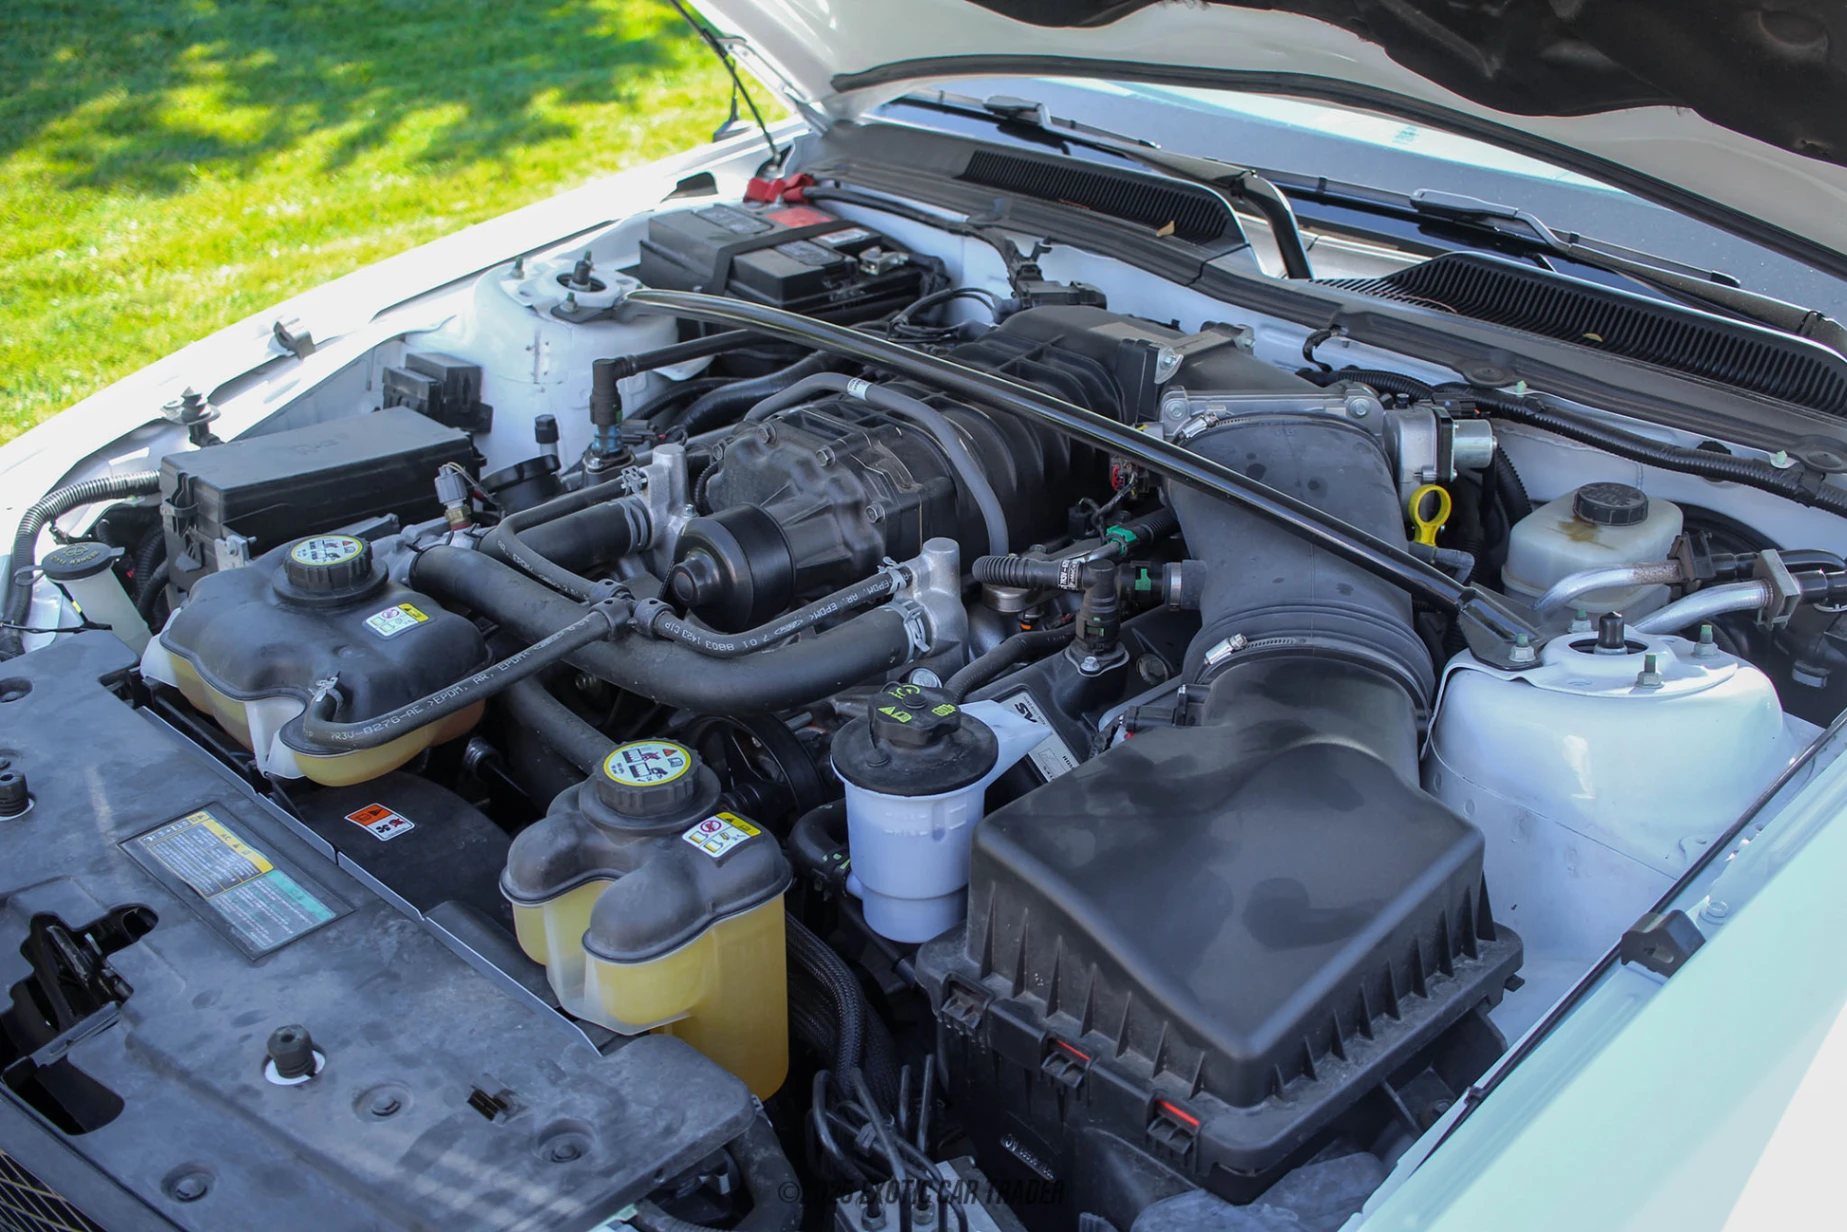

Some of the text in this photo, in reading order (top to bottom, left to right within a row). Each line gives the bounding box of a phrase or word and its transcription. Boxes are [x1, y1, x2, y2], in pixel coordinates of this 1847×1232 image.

[841, 592, 859, 604] AR,
[809, 602, 838, 620] EPDM<
[681, 629, 701, 645] 1423
[705, 640, 735, 651] 8803
[472, 672, 494, 685] AR,
[1014, 702, 1038, 723] SV
